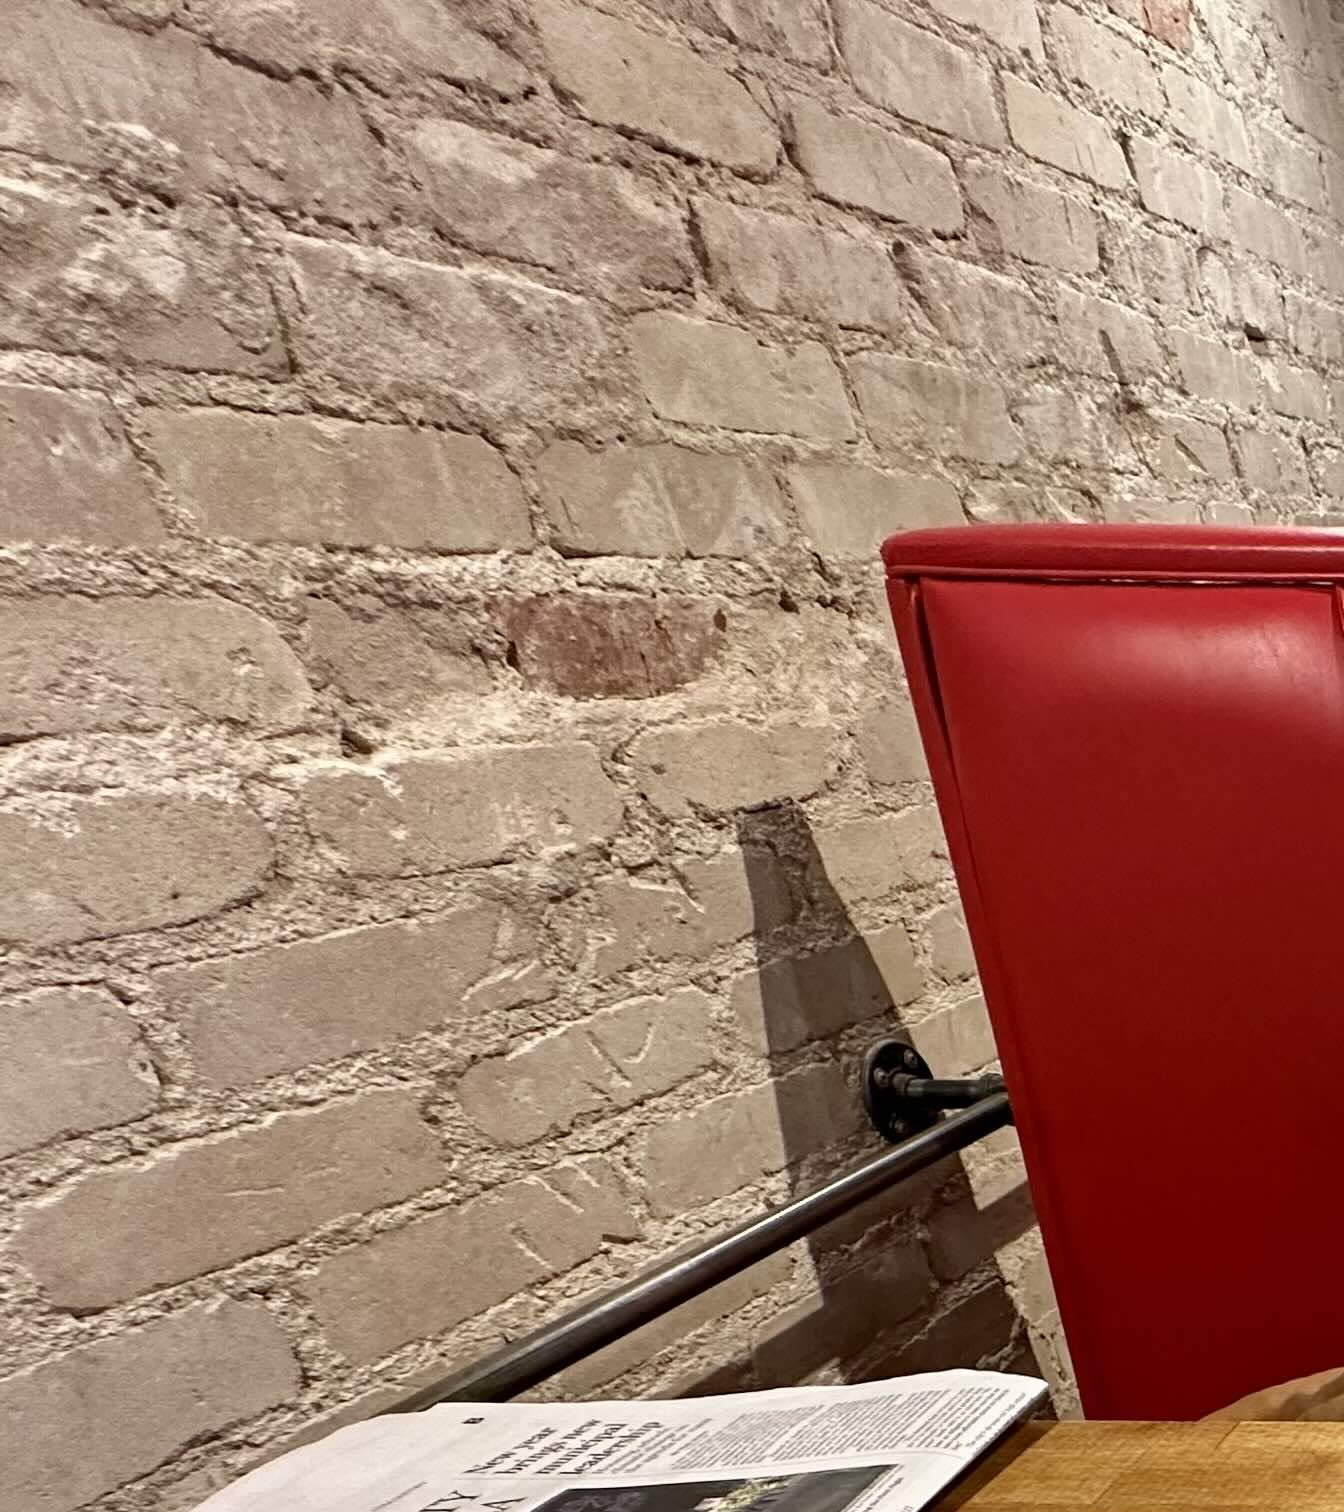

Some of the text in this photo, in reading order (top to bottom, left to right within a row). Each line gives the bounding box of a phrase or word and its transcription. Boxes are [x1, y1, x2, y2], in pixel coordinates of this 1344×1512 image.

[462, 1426, 558, 1474] New year
[493, 1419, 601, 1474] brings new
[535, 1423, 627, 1475] municipal
